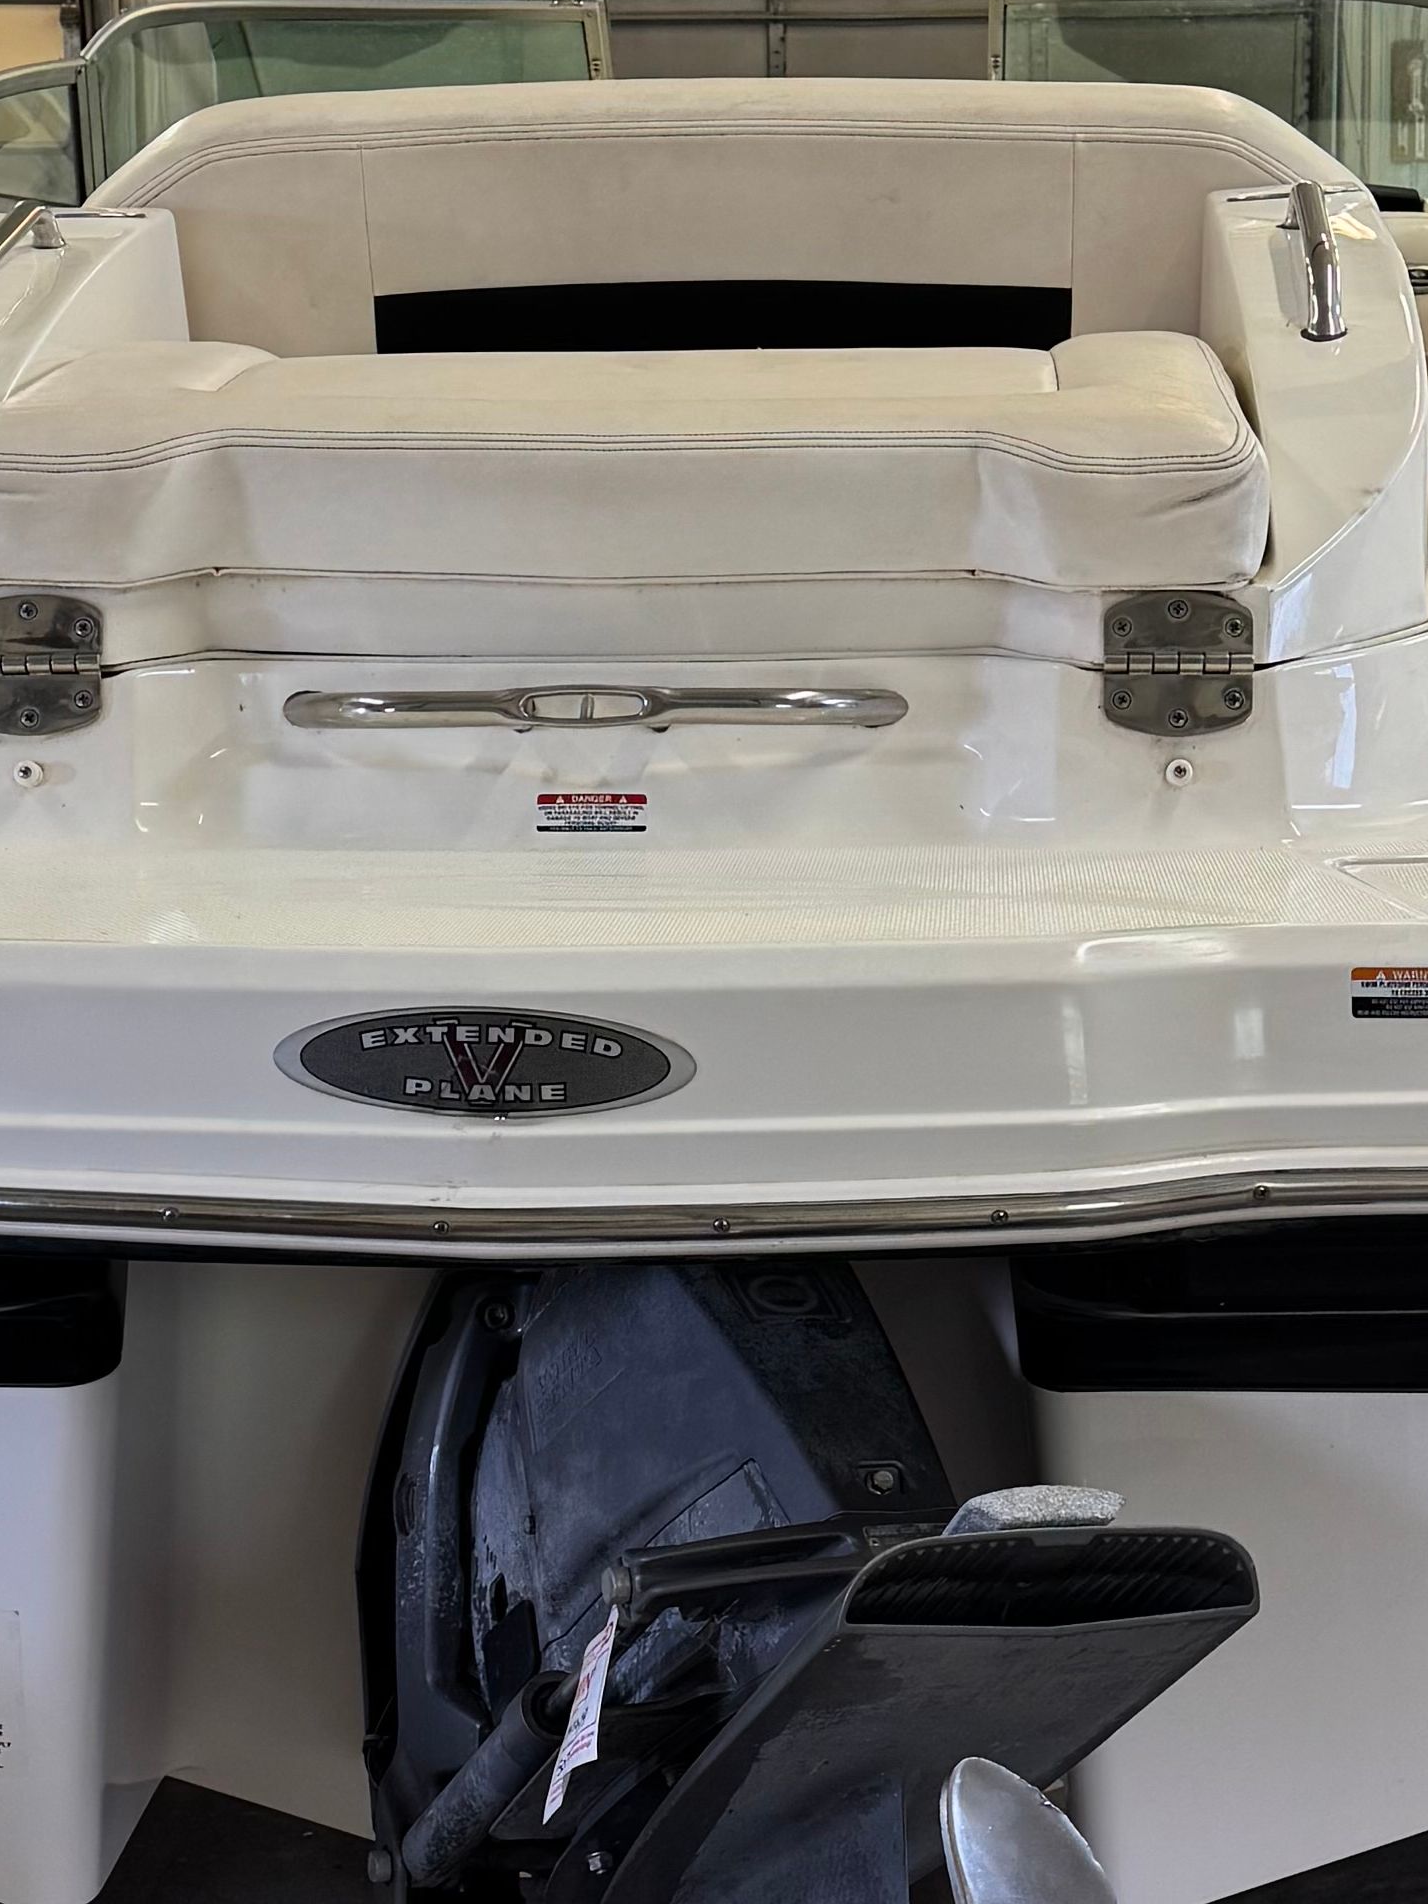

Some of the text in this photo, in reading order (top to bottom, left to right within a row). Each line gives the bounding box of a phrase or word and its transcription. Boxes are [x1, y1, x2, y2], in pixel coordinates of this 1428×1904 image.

[572, 795, 612, 803] DANGER
[360, 1022, 623, 1058] EXTENDED
[402, 1076, 567, 1105] PLANE
